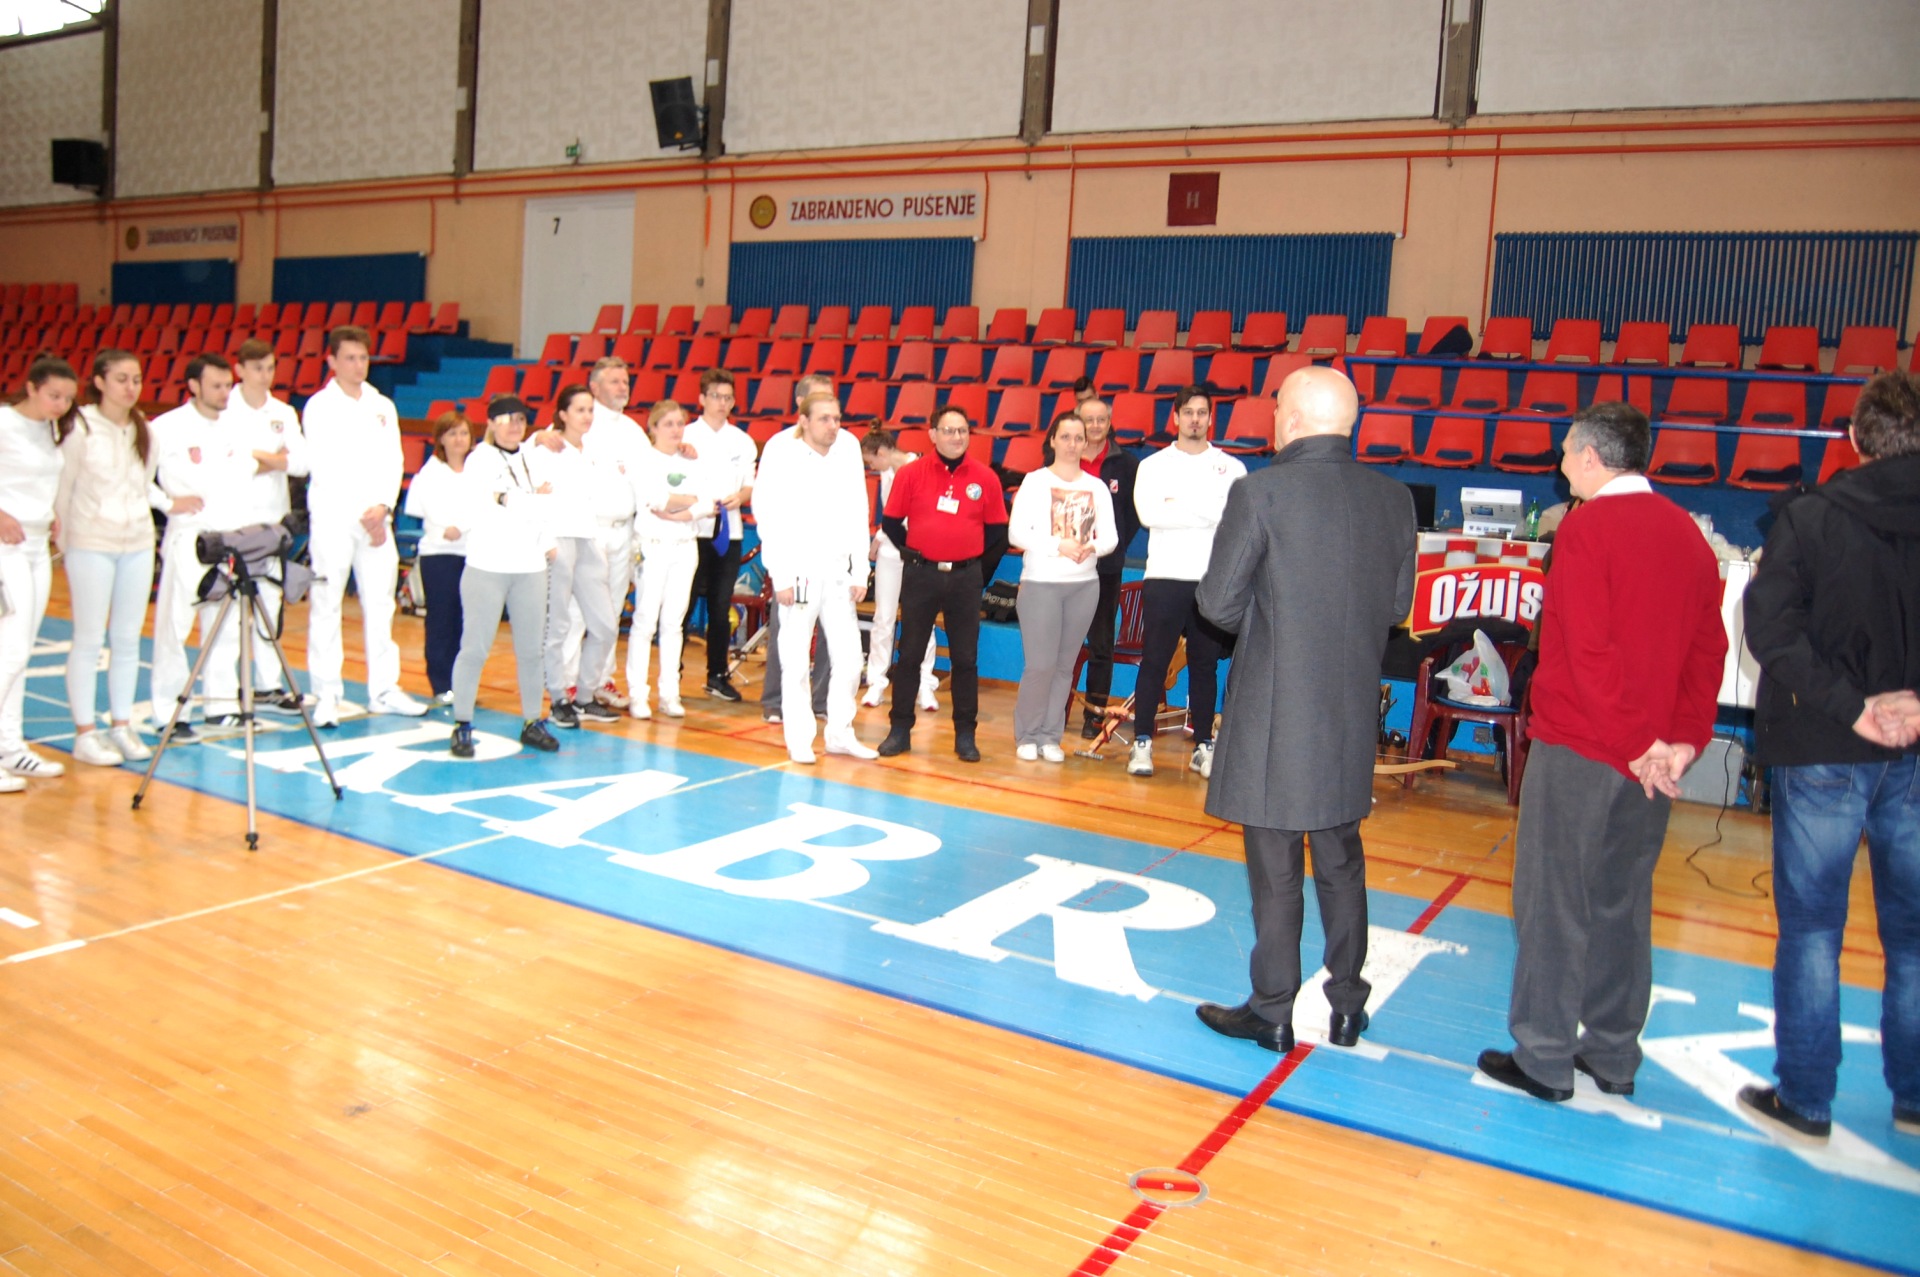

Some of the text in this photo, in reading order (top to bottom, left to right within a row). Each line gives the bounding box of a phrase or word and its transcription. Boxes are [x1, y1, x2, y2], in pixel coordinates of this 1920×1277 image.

[790, 194, 976, 221] ZABRANJENO PUŠENJE
[553, 217, 561, 235] 7
